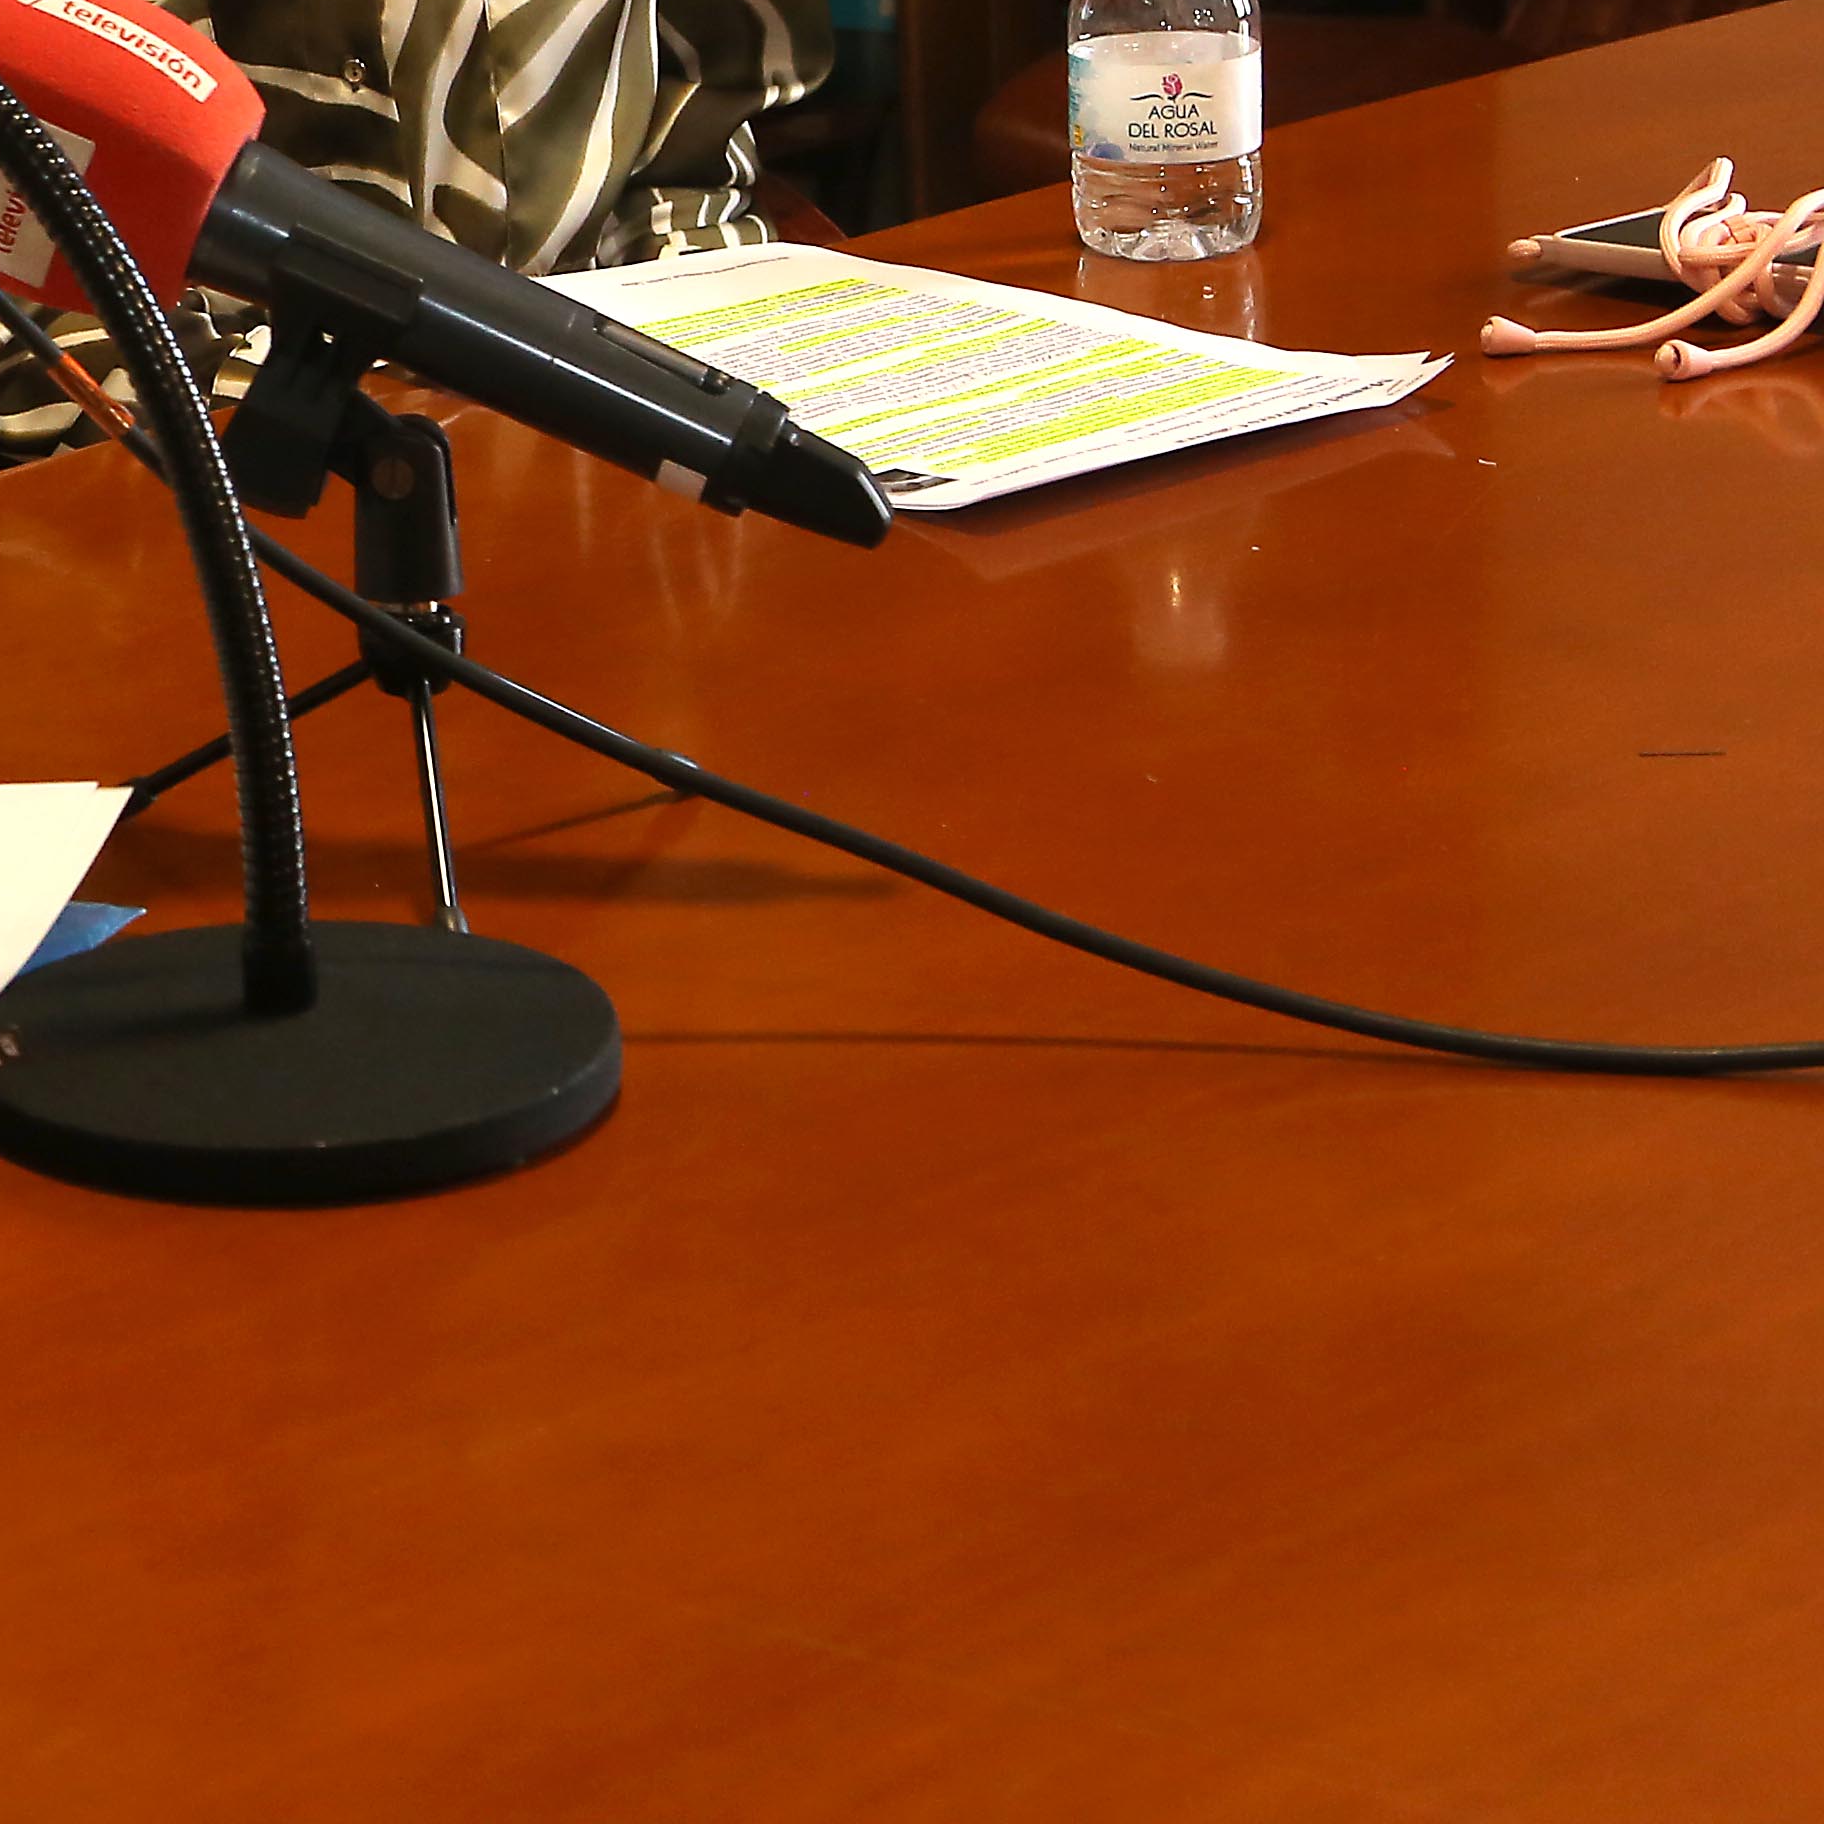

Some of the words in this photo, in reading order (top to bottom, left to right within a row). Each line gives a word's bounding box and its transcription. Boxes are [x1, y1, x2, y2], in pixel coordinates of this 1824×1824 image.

[1148, 103, 1201, 121] AGUA
[1128, 122, 1160, 140] DEL
[1164, 121, 1219, 140] ROSAL
